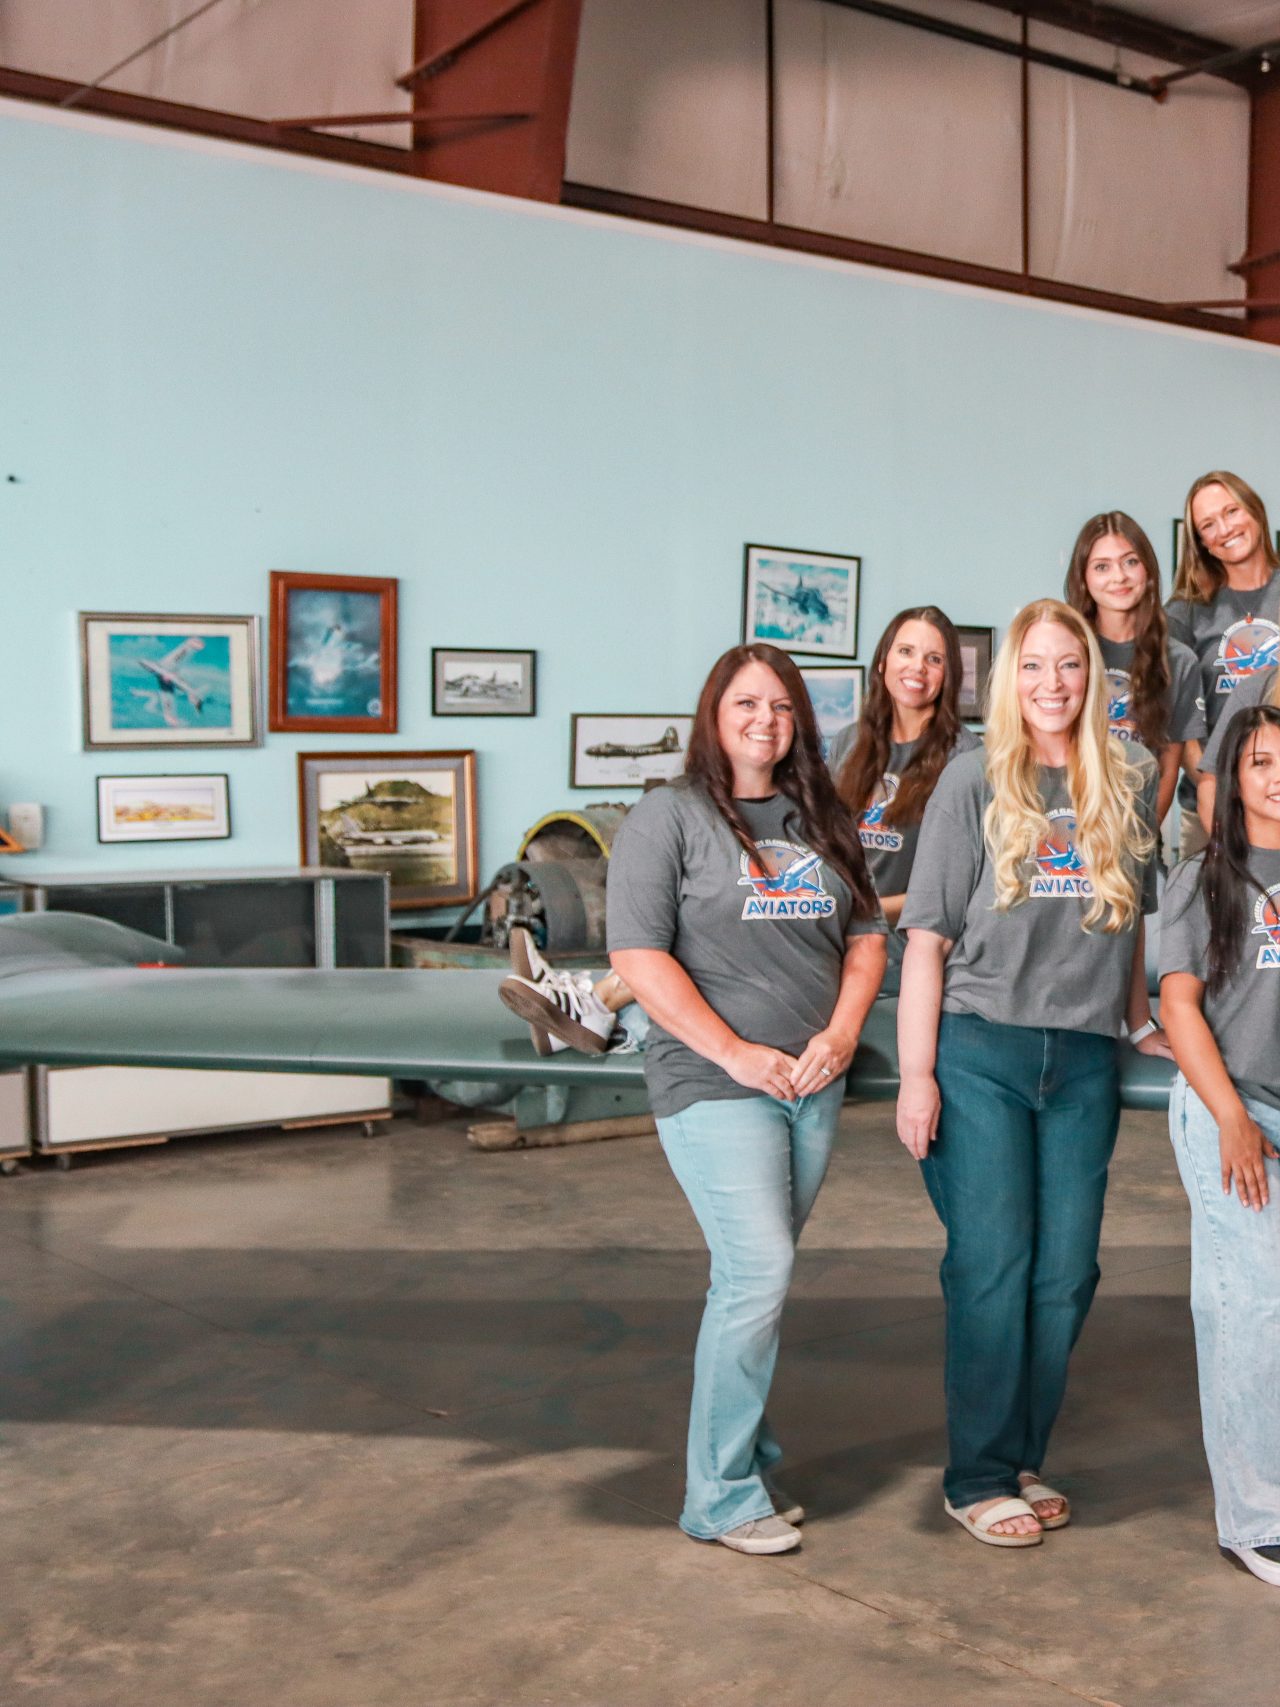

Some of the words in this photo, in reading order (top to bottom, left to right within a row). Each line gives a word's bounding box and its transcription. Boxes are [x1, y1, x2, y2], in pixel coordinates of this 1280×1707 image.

[859, 831, 899, 849] ATORS
[1034, 879, 1093, 893] AVIATO
[747, 900, 833, 915] AVIATORS
